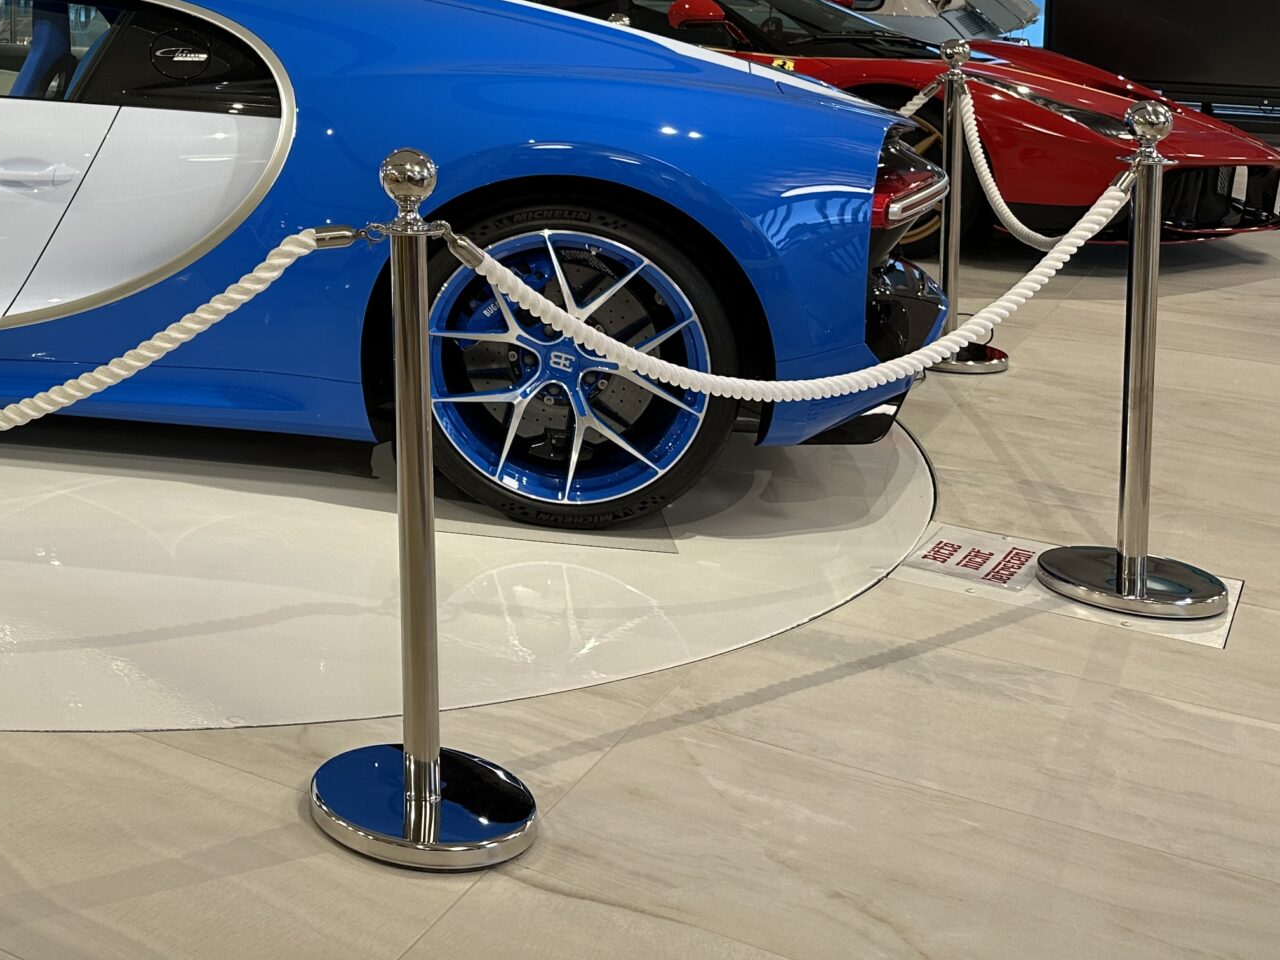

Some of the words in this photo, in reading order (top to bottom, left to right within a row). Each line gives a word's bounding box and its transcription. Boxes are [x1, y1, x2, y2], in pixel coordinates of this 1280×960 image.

[513, 209, 590, 225] MICHELIN
[921, 540, 962, 564] Bitte
[955, 548, 994, 571] nicht
[980, 547, 1036, 584] betreten!
